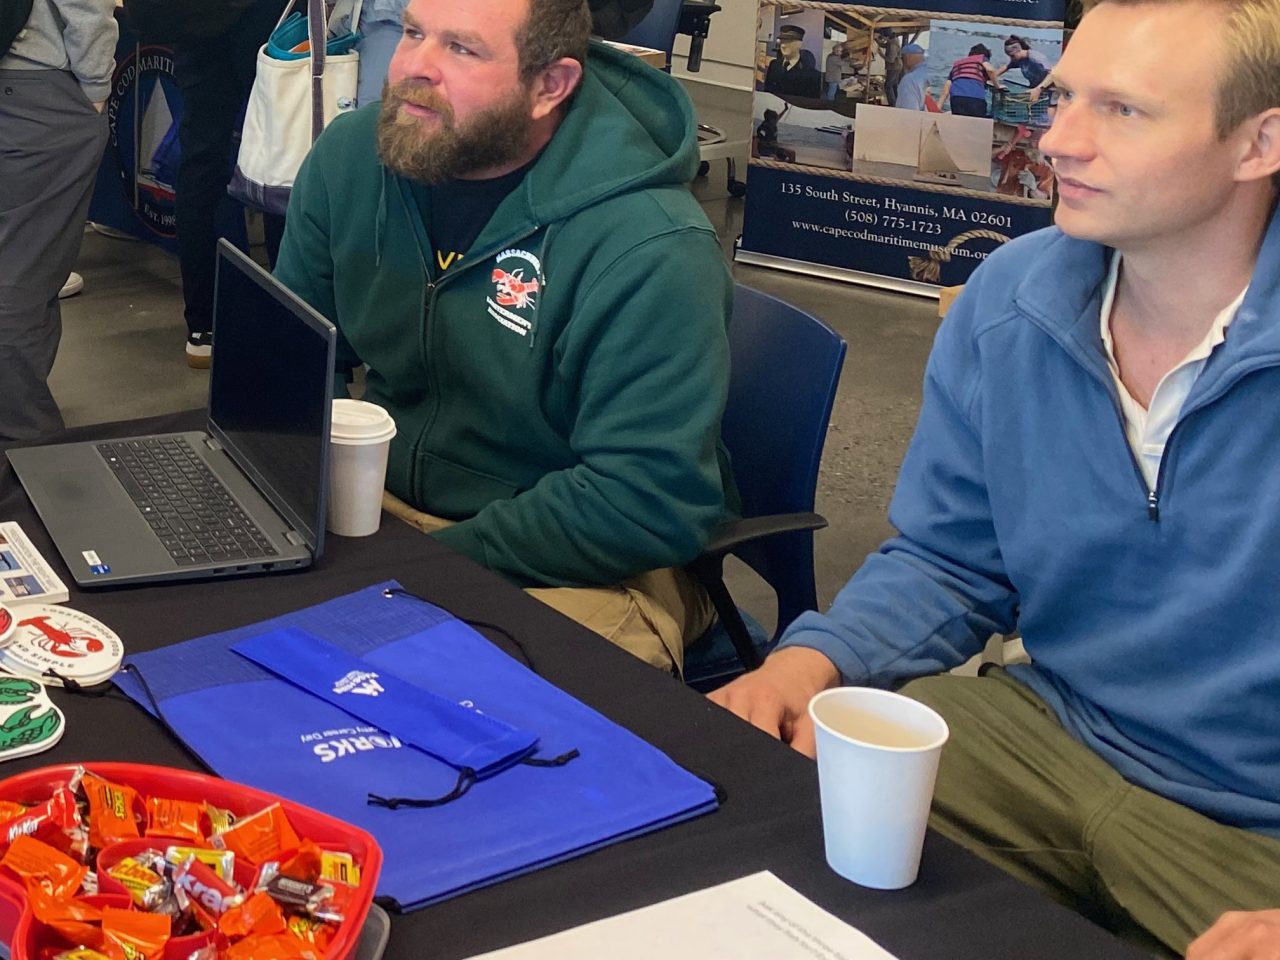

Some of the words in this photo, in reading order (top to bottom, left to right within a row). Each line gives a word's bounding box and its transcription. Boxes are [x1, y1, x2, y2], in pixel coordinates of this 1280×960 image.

[108, 98, 121, 147] CAPE
[117, 65, 136, 96] COD
[781, 182, 801, 195] 135
[805, 186, 838, 201] South
[842, 190, 881, 208] Street,
[884, 198, 938, 217] Hyannis,
[942, 207, 967, 221] MA
[971, 211, 1012, 228] 02601
[845, 210, 878, 225] (508)
[882, 216, 942, 235] 775-1723
[31, 652, 75, 668] SIMPLE
[301, 733, 323, 743] Day
